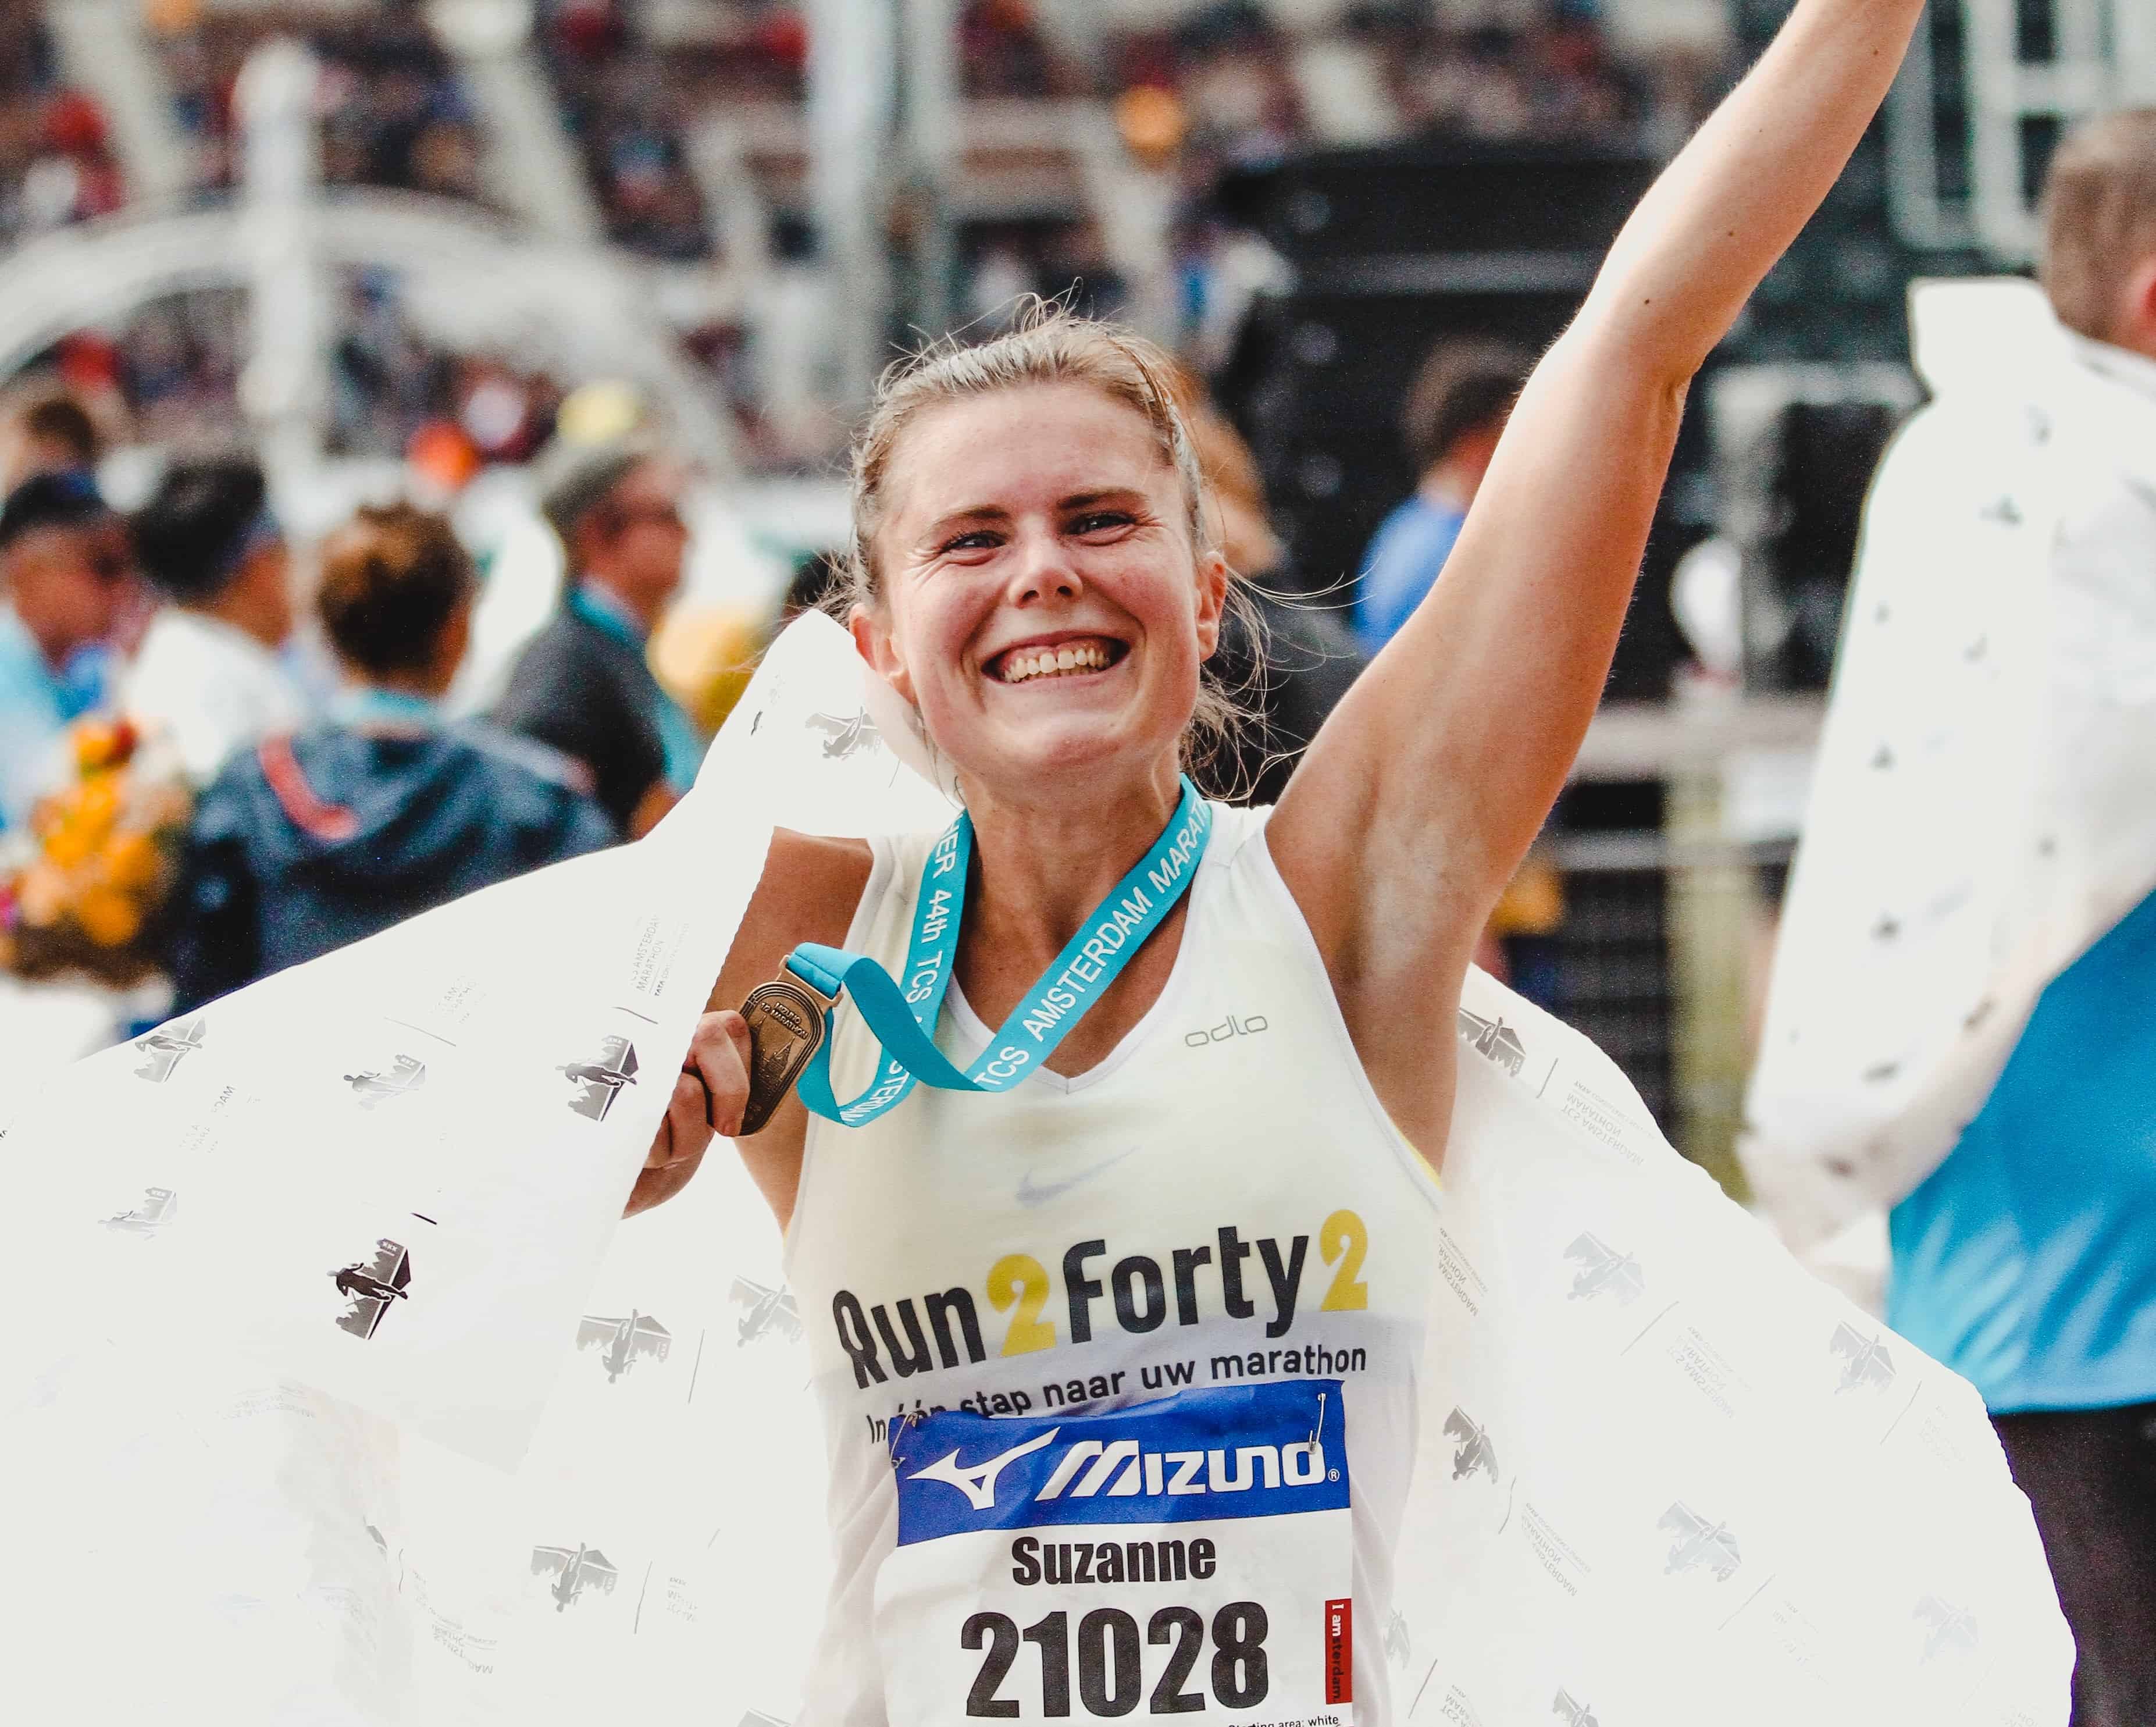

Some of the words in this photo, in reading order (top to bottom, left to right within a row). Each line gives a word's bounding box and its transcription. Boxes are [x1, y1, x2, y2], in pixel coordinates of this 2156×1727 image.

[921, 889, 952, 944] 44th
[973, 1046, 1029, 1085] TCS
[1022, 886, 1153, 1042] AMSTERDAM
[1148, 797, 1207, 893] MARAT
[636, 939, 666, 991] MARATHON
[905, 949, 943, 1005] TCS
[771, 1009, 808, 1040] MARATHON
[1185, 1015, 1268, 1048] odlo
[1042, 1370, 1126, 1408] naar
[1141, 1360, 1196, 1389] uw
[1210, 1344, 1366, 1380] marathon
[1011, 1536, 1217, 1586] Suzanne
[960, 1601, 1269, 1719] 21028
[1308, 1714, 1339, 1726] white
